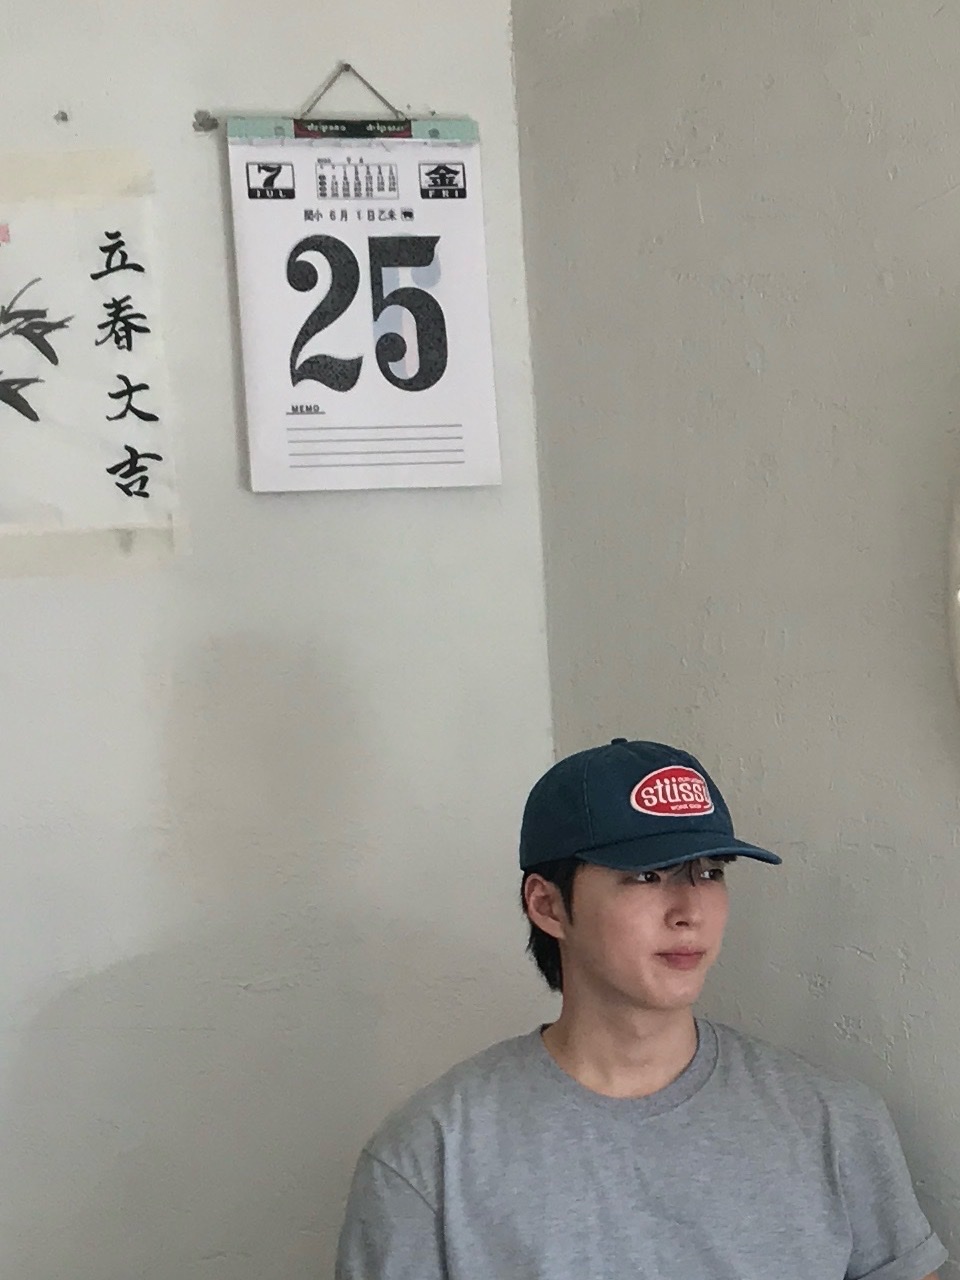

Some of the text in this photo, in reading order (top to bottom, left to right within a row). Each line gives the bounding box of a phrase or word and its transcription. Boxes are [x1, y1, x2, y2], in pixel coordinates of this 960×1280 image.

[257, 162, 282, 188] 7
[425, 163, 460, 187] 金
[256, 189, 287, 198] JUL
[428, 189, 458, 198] FRI
[286, 234, 449, 392] 25
[90, 231, 163, 499] 立春大吉
[291, 404, 320, 413] MEMO
